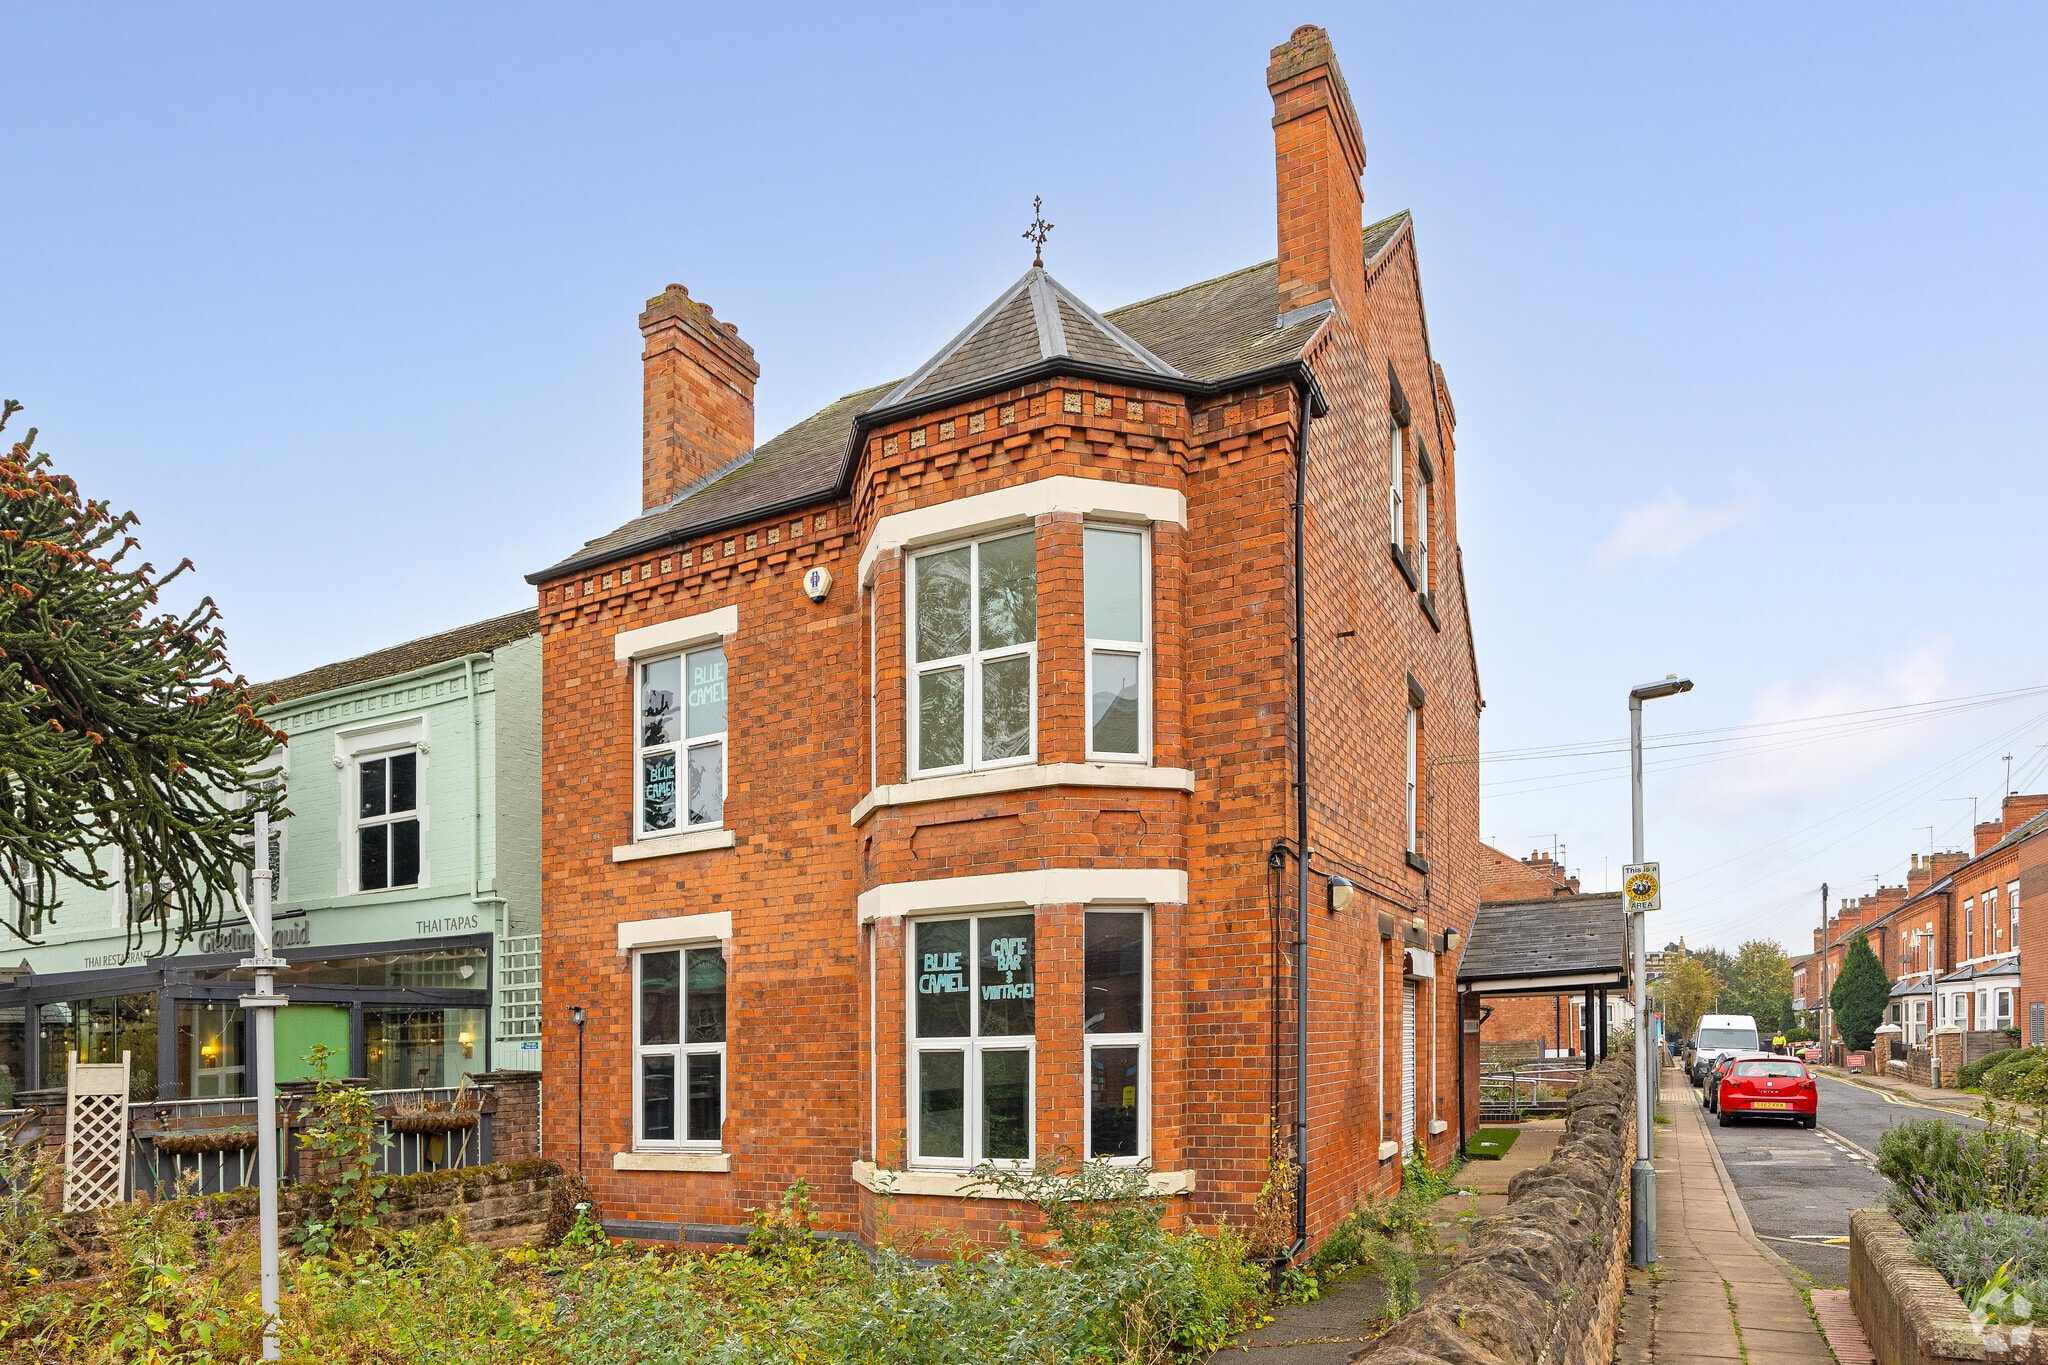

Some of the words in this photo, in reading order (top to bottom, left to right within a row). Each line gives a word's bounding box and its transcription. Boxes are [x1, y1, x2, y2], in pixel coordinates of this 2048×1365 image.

[694, 662, 724, 686] BLUE
[688, 682, 728, 707] CAMEL
[650, 766, 675, 782] BLUE
[1631, 901, 1653, 909] AREA
[416, 919, 442, 934] THAI
[444, 914, 478, 931] TAPAS
[199, 926, 255, 954] Gigglin
[272, 920, 311, 949] quid
[991, 937, 1027, 957] CAFE
[84, 956, 102, 969] THAI
[923, 952, 962, 972] BLUE
[998, 954, 1022, 972] BAR
[919, 973, 969, 994] CAMEL
[981, 983, 1035, 1000] VINTAGE!
